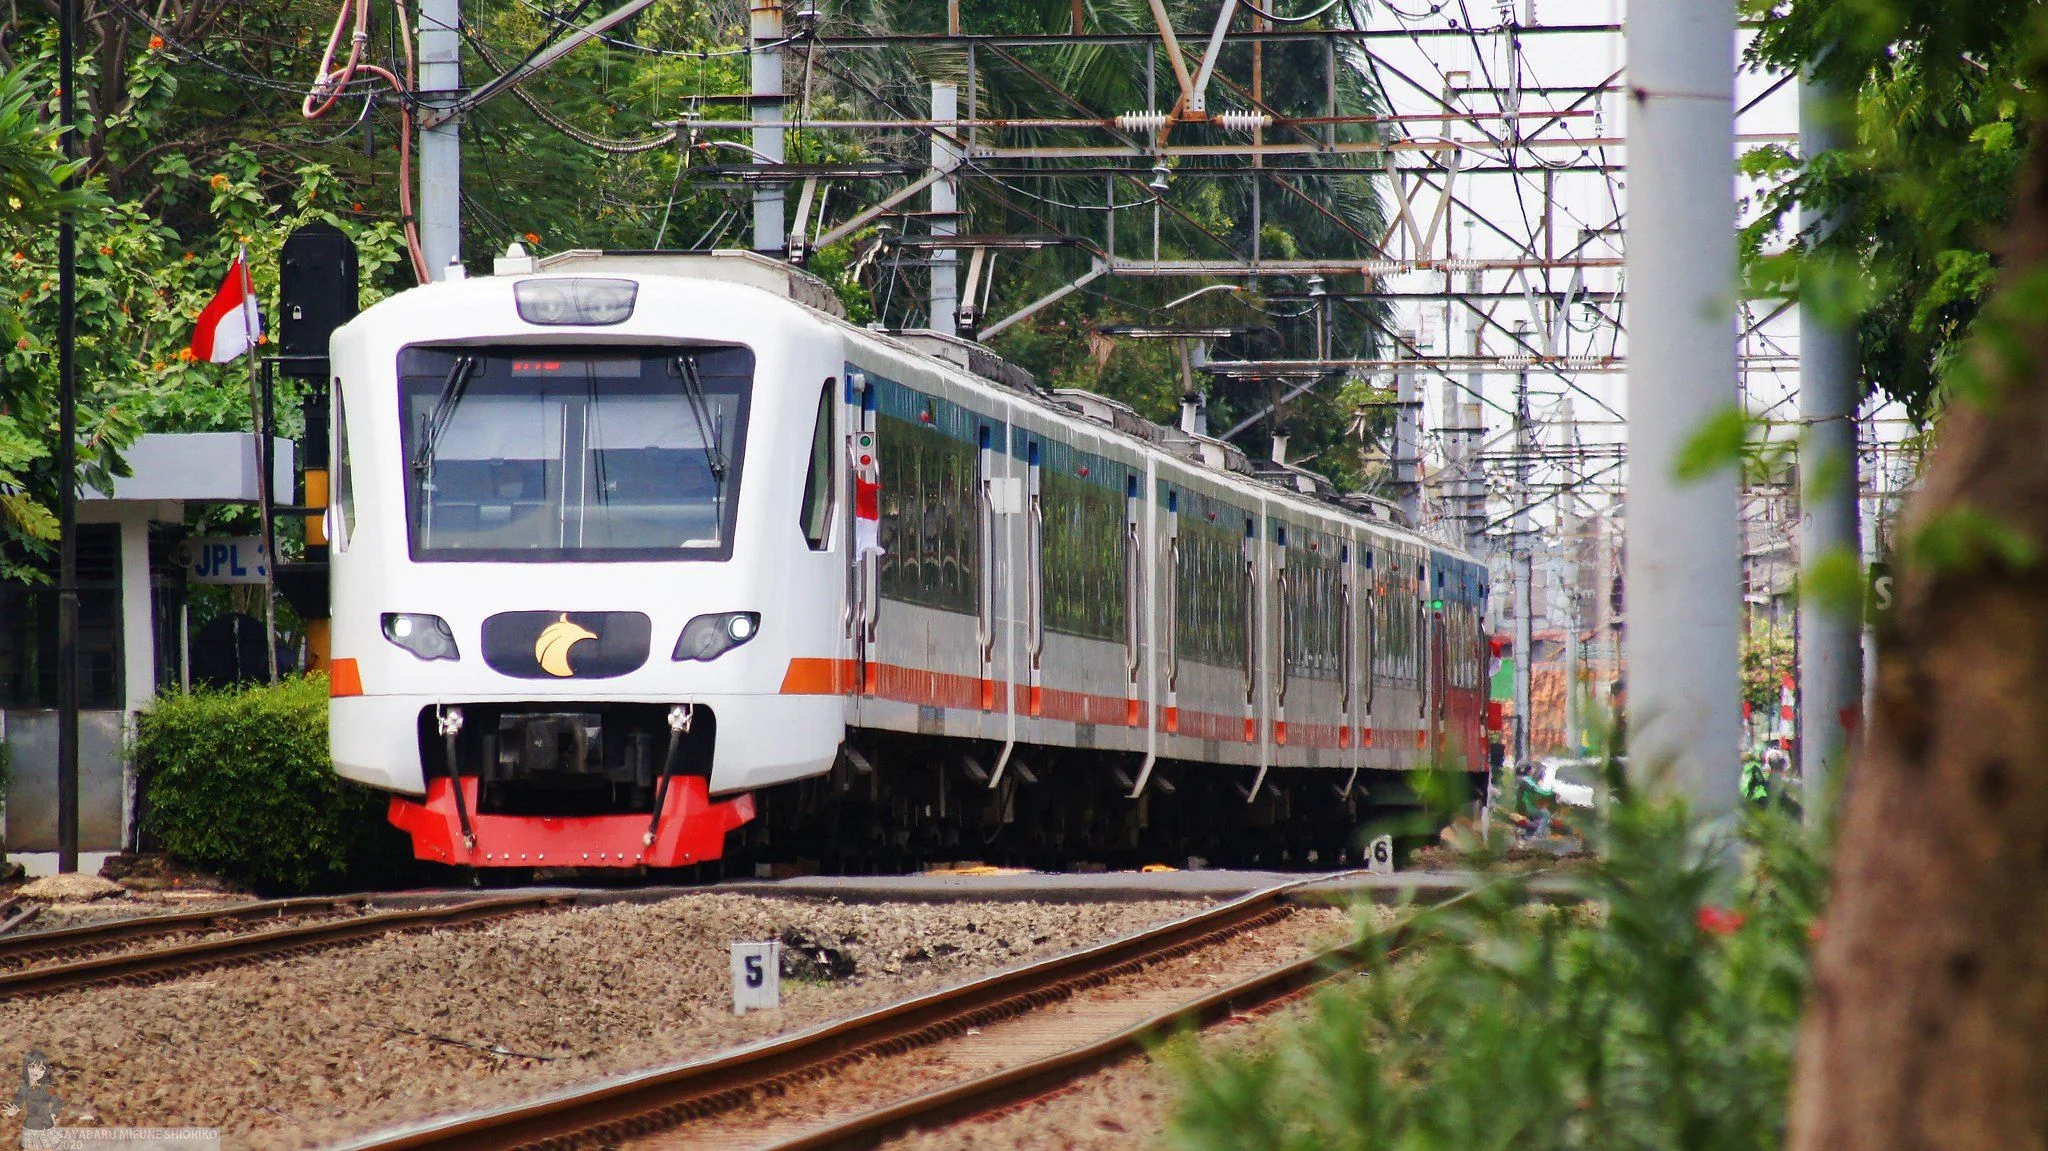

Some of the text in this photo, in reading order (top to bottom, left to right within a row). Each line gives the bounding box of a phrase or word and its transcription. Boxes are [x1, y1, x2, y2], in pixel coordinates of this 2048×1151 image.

[195, 543, 246, 577] JPL
[1374, 840, 1388, 863] 6
[744, 954, 763, 989] 5
